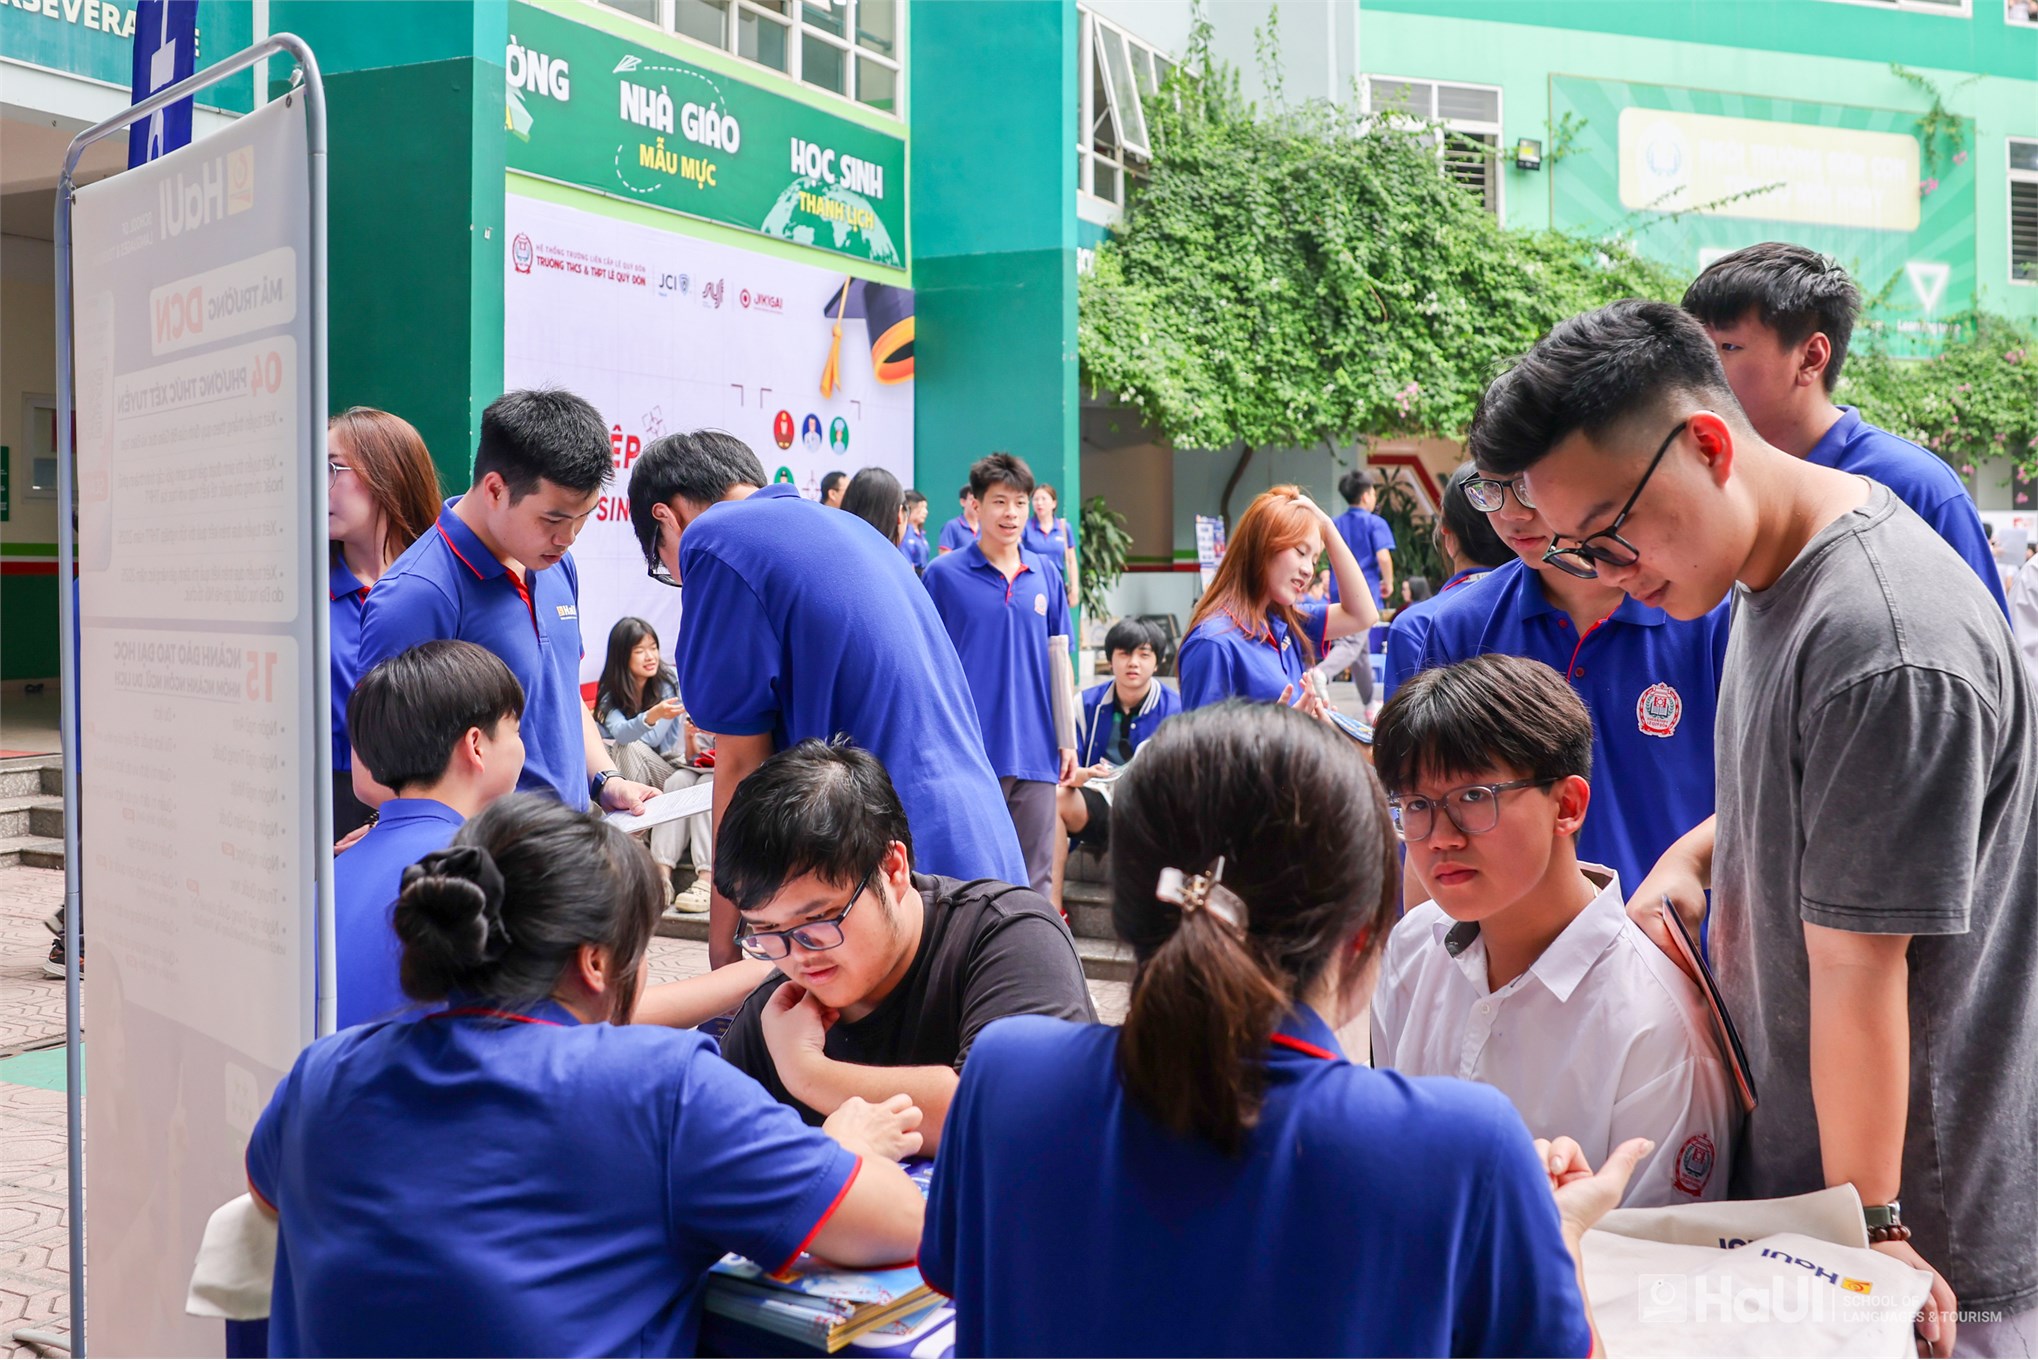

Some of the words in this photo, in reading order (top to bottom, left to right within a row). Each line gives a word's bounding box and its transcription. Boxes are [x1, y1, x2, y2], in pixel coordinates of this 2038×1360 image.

[620, 80, 674, 134] NHÀ
[681, 102, 741, 154] GIÁO
[639, 136, 678, 175] MẪU
[680, 158, 717, 190] MỰC
[790, 136, 836, 188] HỌC
[840, 154, 884, 200] SINH
[799, 190, 845, 223] THANH
[846, 204, 875, 233] LỊCH
[583, 265, 589, 275] &
[658, 273, 677, 291] JCI
[1760, 1248, 1839, 1285] HaUI
